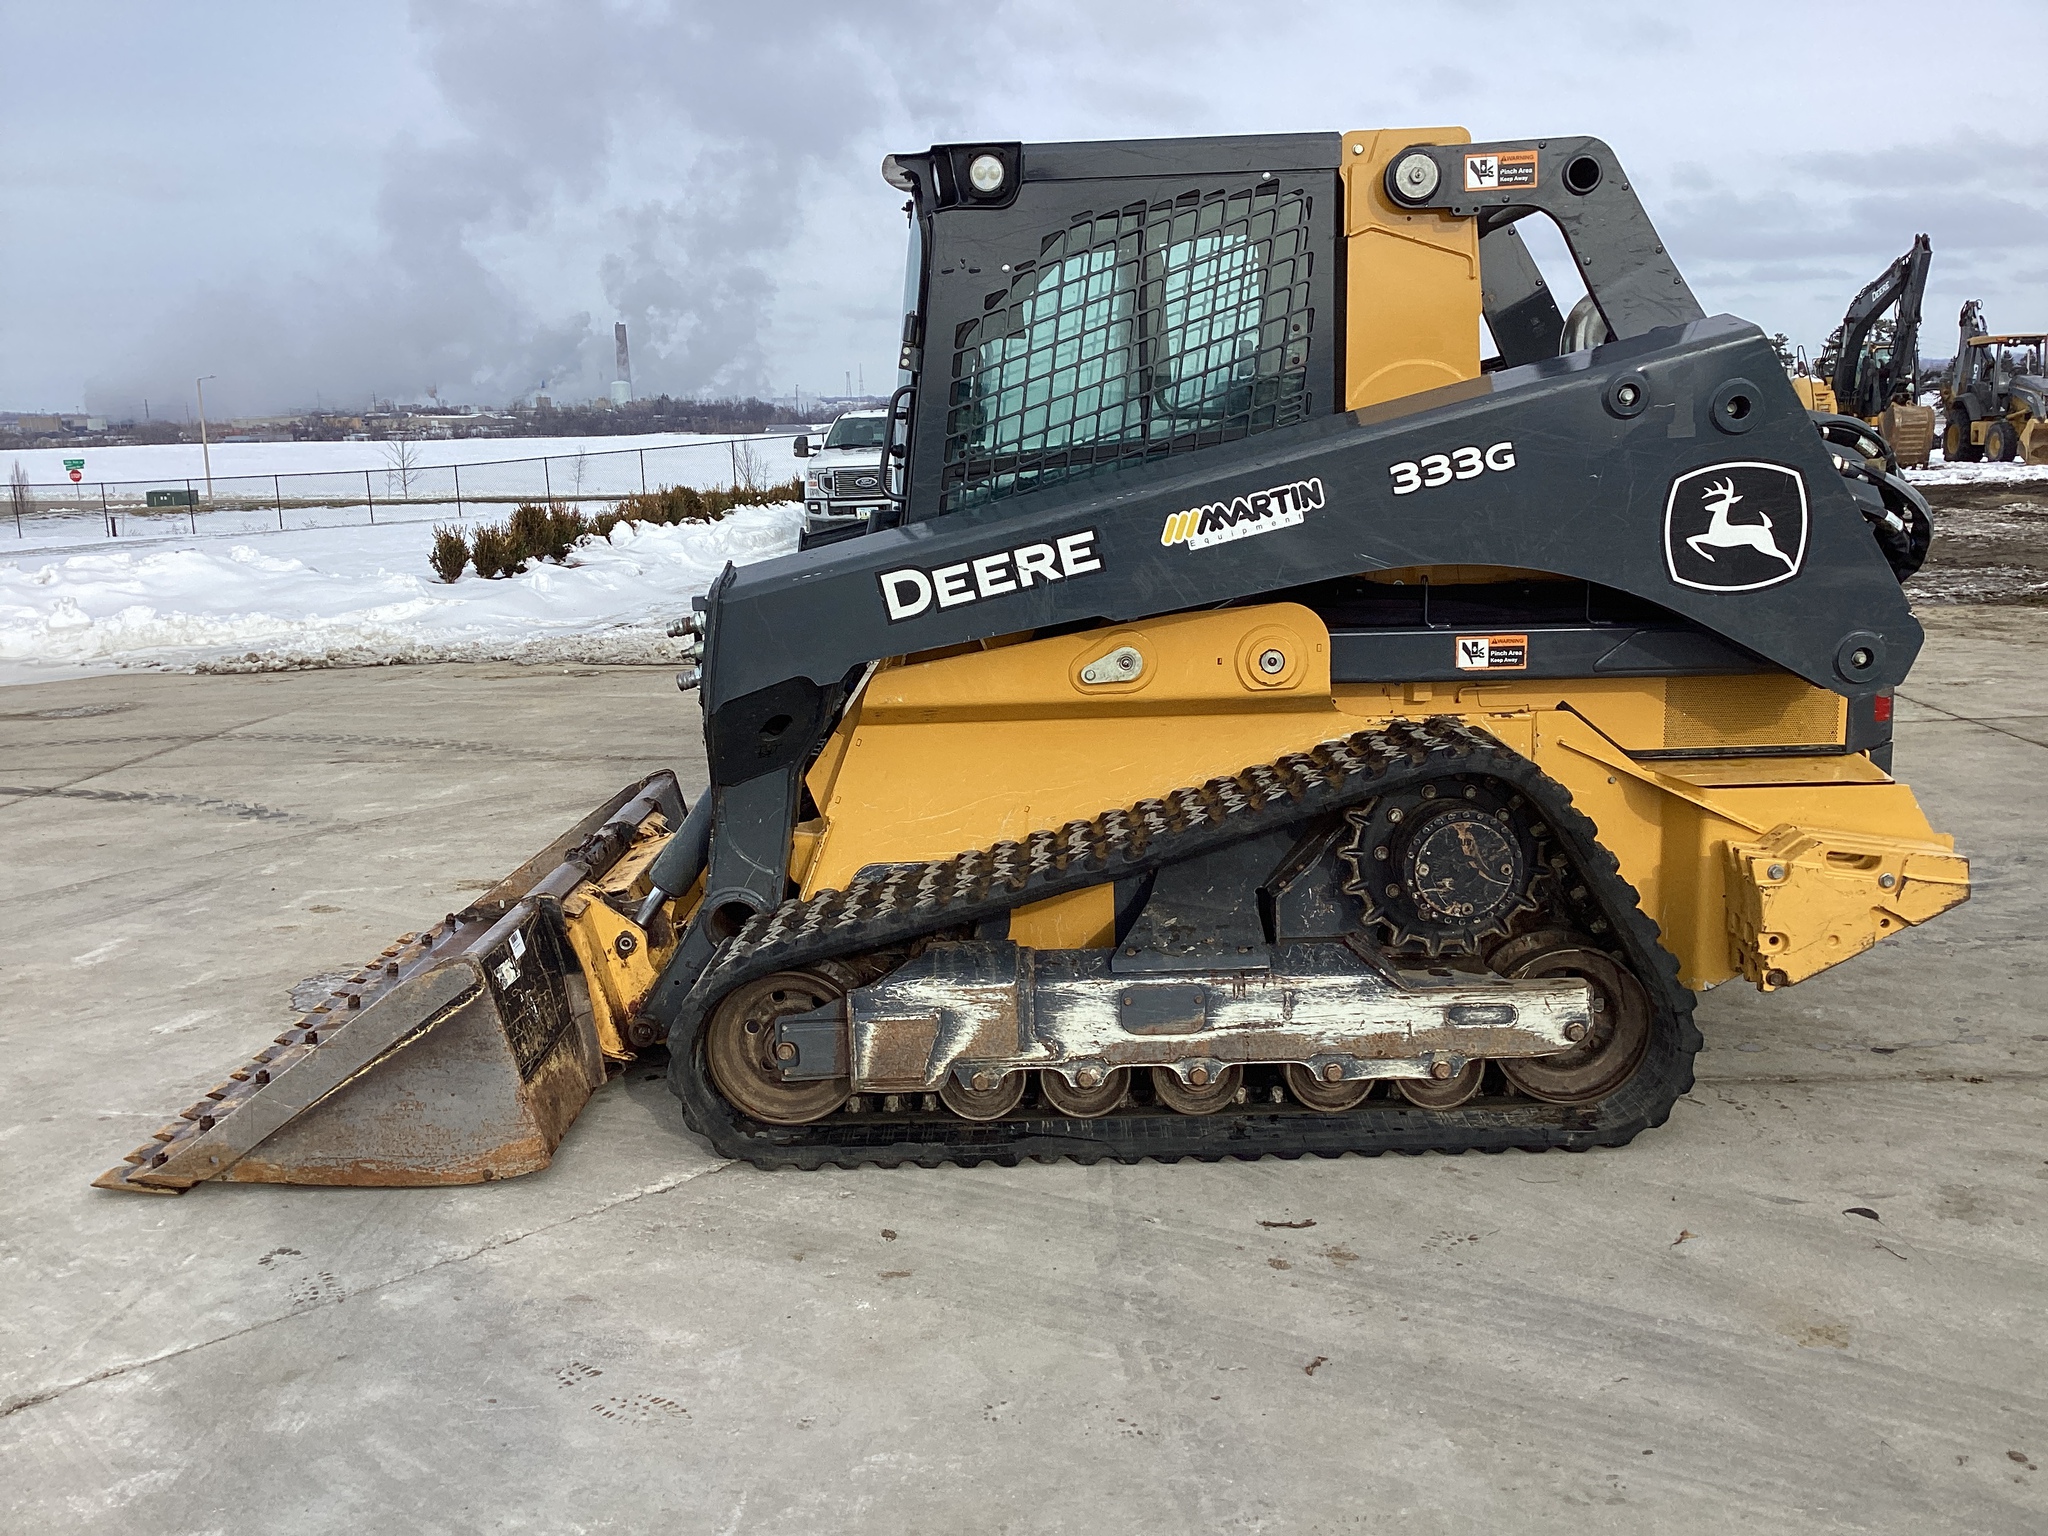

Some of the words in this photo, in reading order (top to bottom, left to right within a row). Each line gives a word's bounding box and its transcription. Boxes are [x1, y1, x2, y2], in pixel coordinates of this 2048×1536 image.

[1506, 154, 1535, 162] WARNING
[1872, 280, 1890, 302] DEERE
[1389, 441, 1517, 495] 333G
[1197, 480, 1323, 535] MARTIN
[1190, 514, 1302, 548] Equipment
[880, 530, 1102, 621] DEERE
